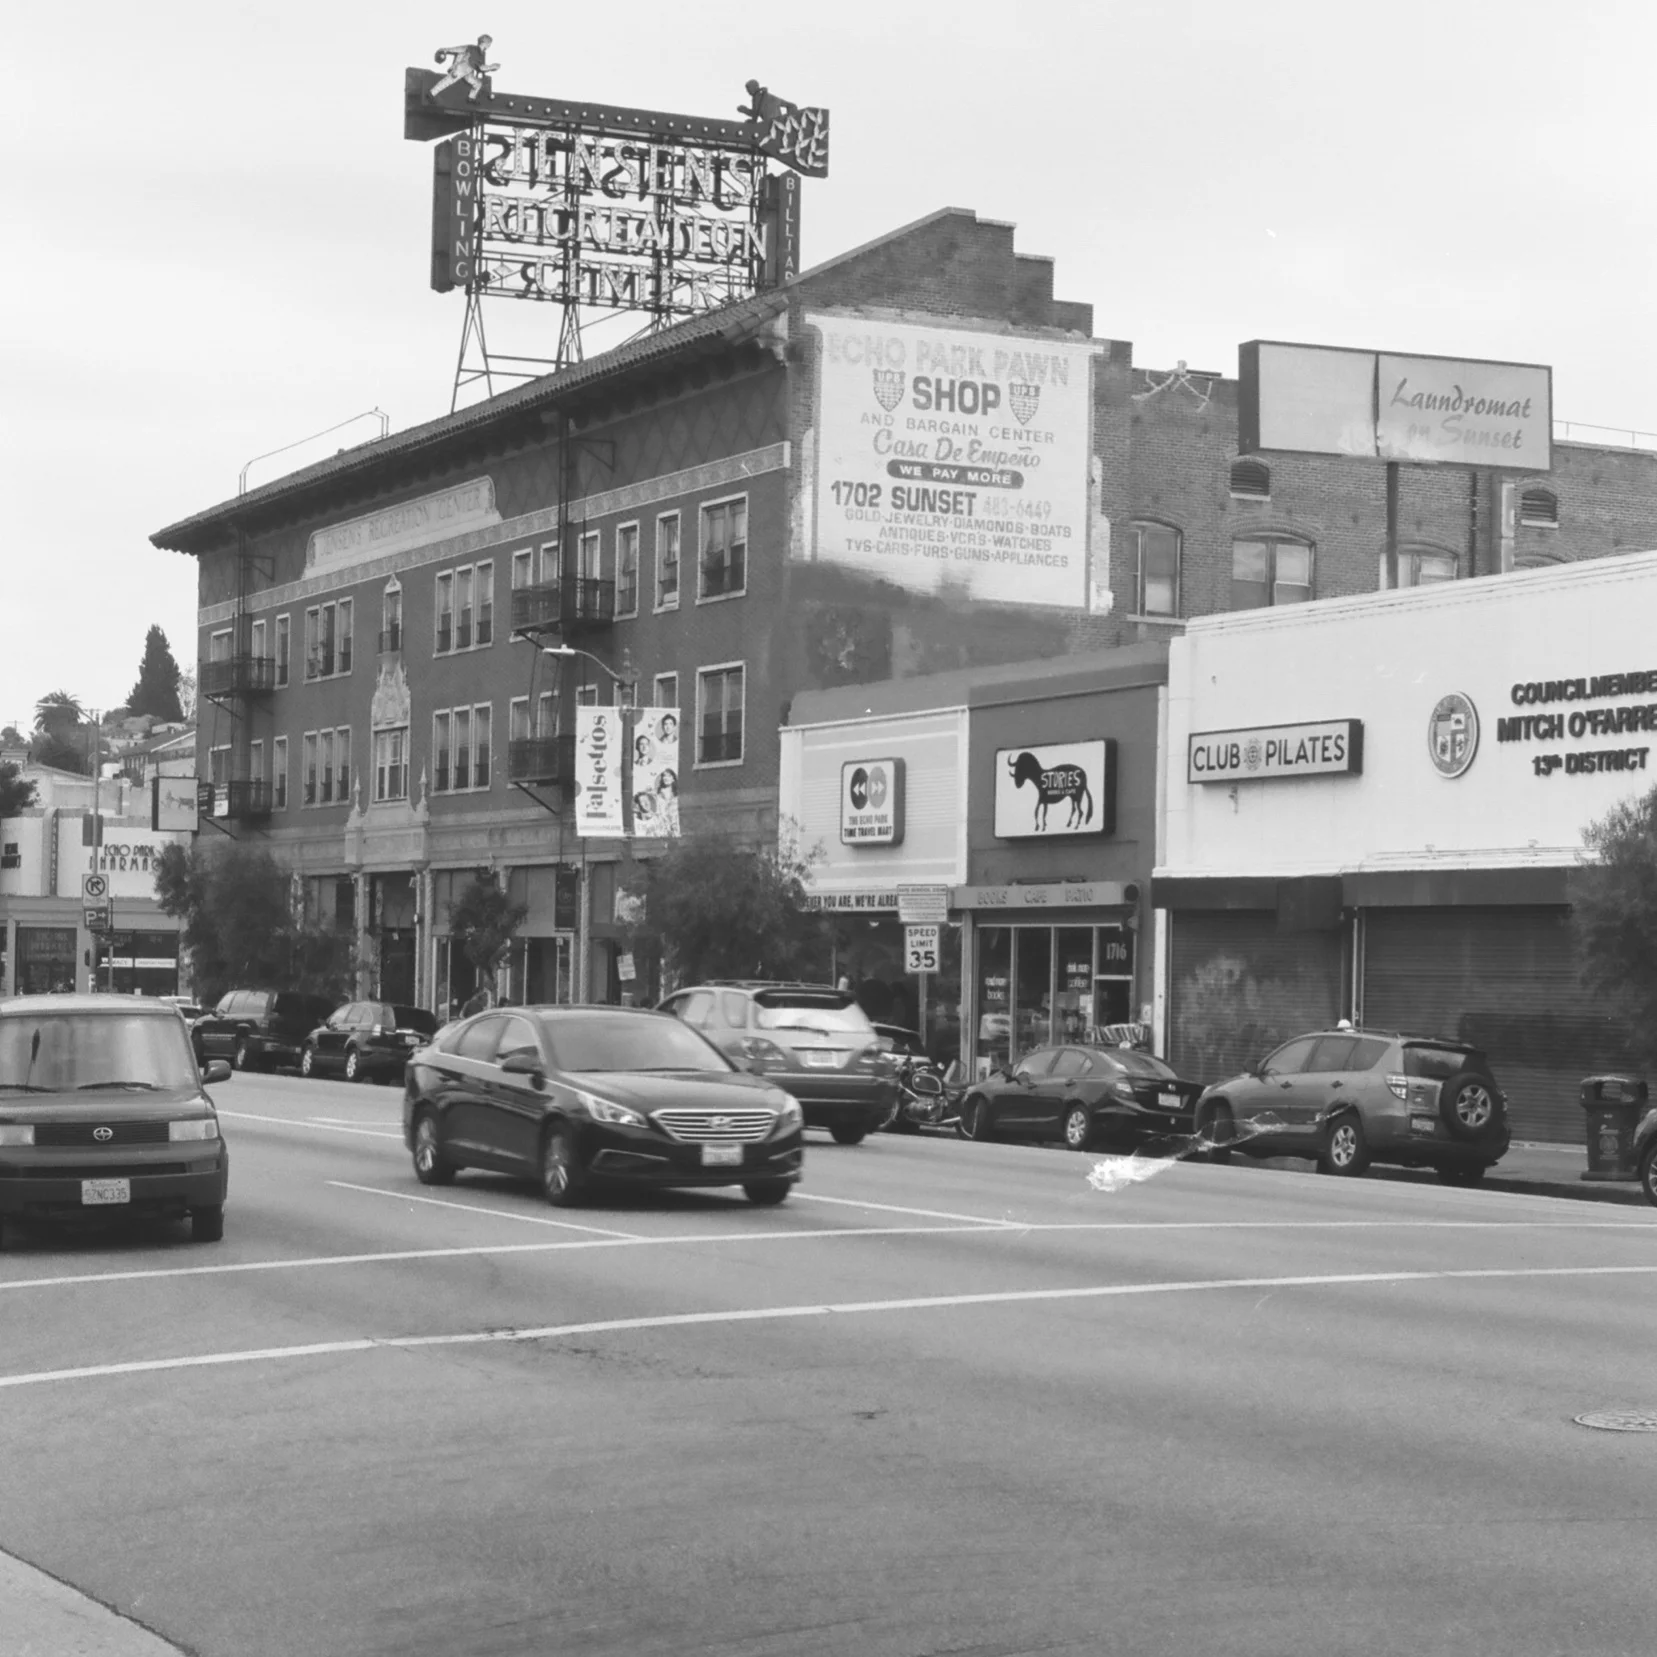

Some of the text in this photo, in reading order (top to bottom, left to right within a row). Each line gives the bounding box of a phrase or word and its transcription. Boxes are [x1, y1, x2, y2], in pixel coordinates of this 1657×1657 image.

[495, 127, 753, 206] JENSEN'S
[455, 140, 471, 278] BOWLING
[484, 193, 767, 261] RECREATION
[534, 254, 718, 309] CENTER
[827, 331, 1069, 387] ECHO PARK PAWN
[912, 376, 1001, 416] SHOP
[1390, 378, 1532, 418] Laundromat
[860, 413, 1055, 444] AND BARGAIN CENTER
[1441, 414, 1523, 450] Sunset
[873, 428, 928, 459] Casa
[935, 437, 962, 461] De
[900, 465, 1012, 484] WE PAY MORE
[831, 480, 882, 507] 1702
[891, 486, 977, 516] SUNSET
[1031, 523, 1072, 537] BOATS
[1497, 713, 1564, 743] MITCH
[1193, 734, 1345, 772] CLUB PILATES
[1565, 746, 1650, 774] DISTRICT
[1041, 769, 1081, 788] STORIES
[104, 844, 131, 856] ECHO
[823, 895, 836, 908] YOU
[908, 928, 937, 937] SPEED
[911, 939, 933, 948] LIMIT
[910, 951, 936, 968] 35
[1106, 943, 1127, 960] 1716
